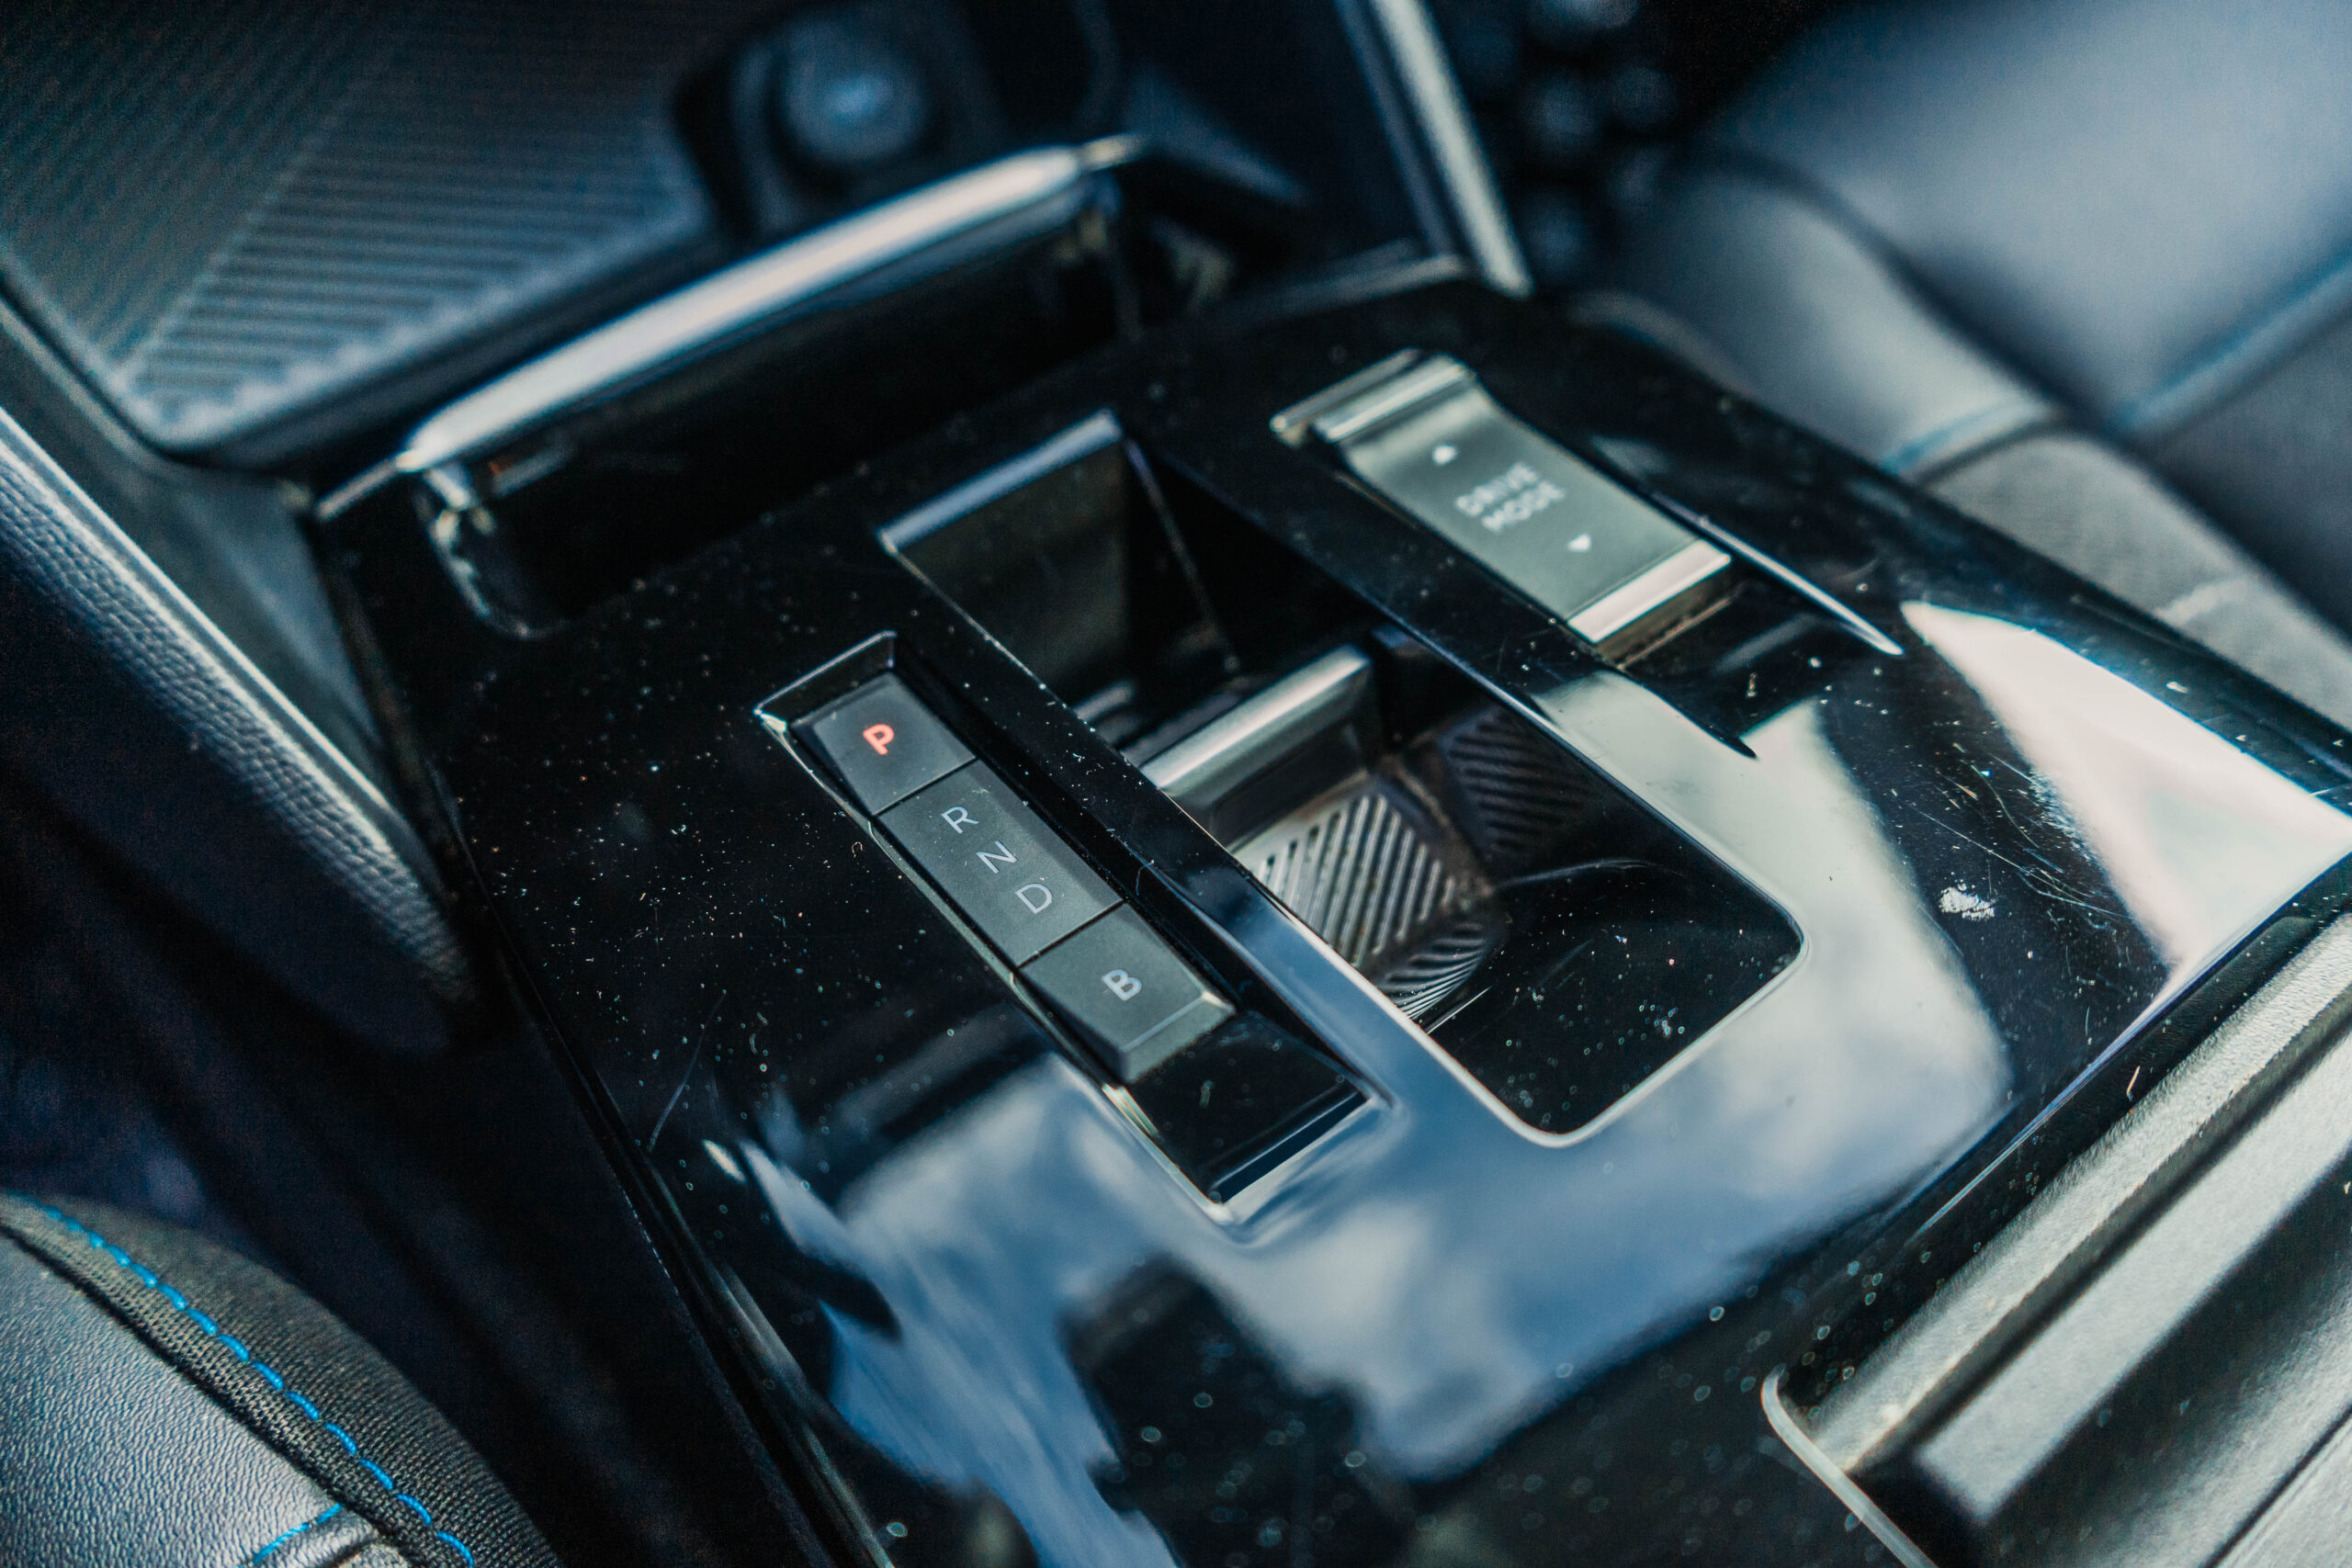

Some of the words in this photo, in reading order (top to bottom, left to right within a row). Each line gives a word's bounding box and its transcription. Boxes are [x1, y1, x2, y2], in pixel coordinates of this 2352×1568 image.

[1455, 462, 1538, 516] DRIVE
[1482, 480, 1564, 534] MODE
[862, 723, 895, 755] P
[940, 806, 979, 834] R
[976, 840, 1018, 874] N
[1014, 882, 1053, 914] D
[1102, 969, 1143, 1001] B
